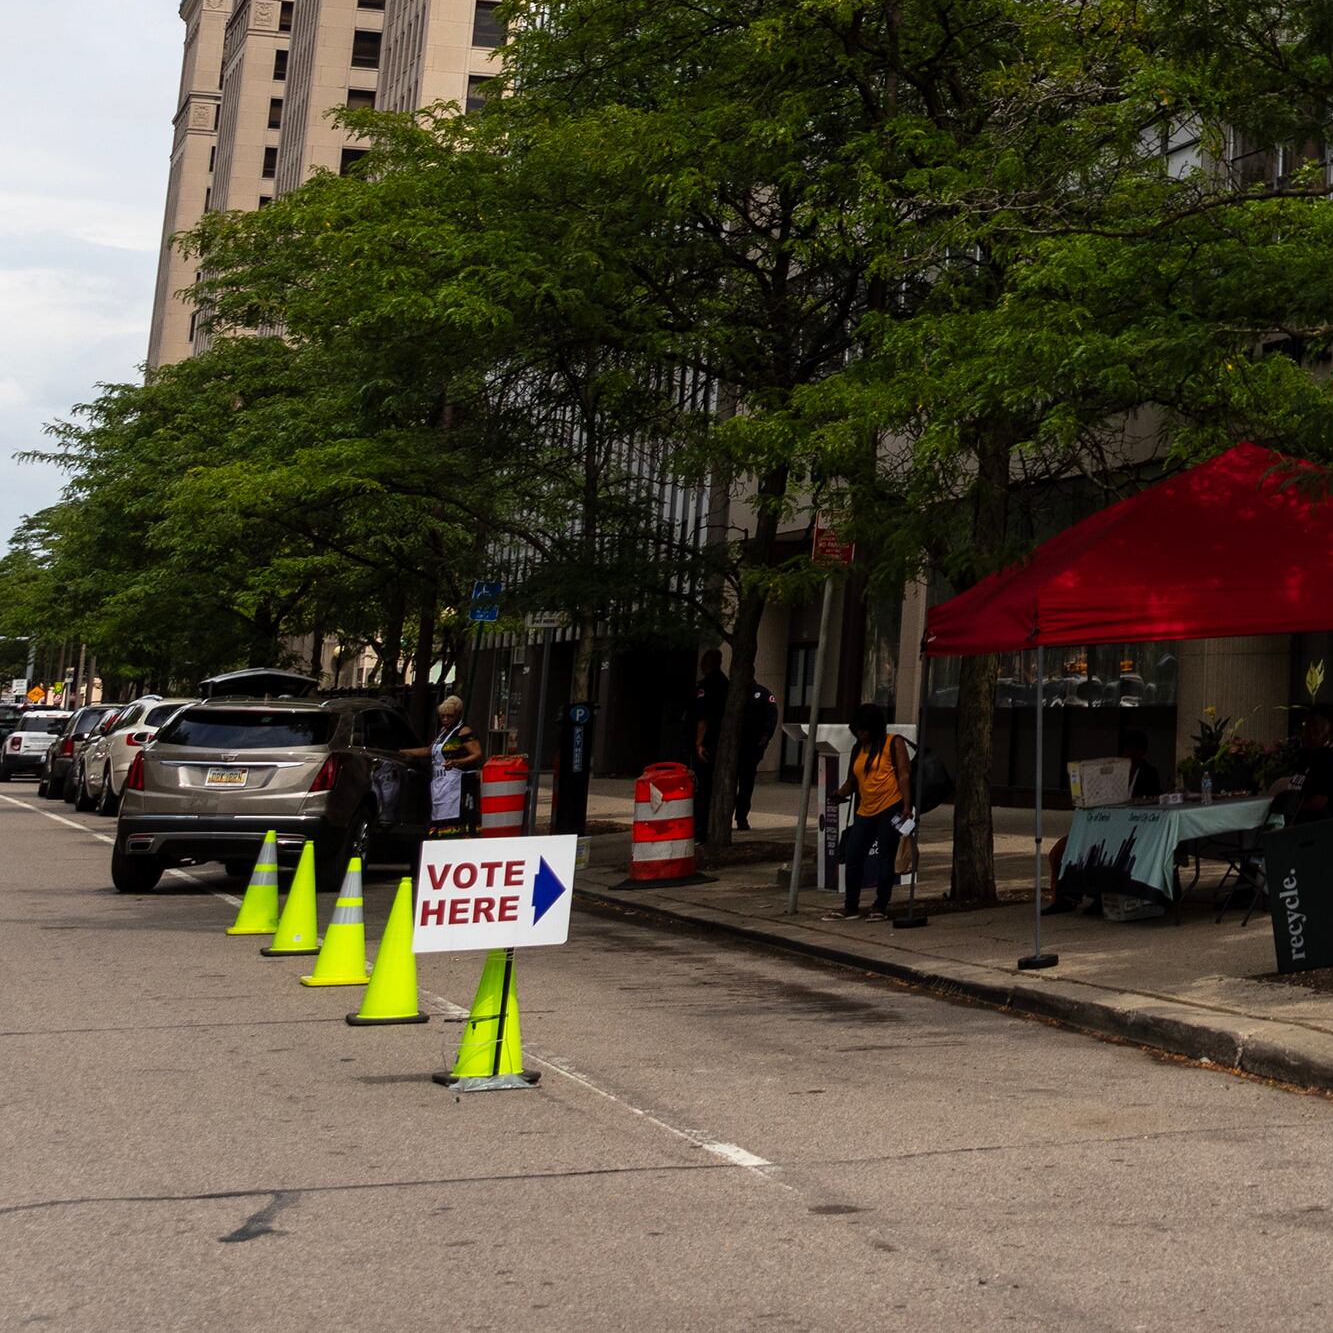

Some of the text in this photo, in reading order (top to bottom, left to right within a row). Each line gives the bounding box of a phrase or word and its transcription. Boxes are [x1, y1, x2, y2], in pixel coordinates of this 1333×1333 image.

[426, 859, 526, 890] VOTE
[419, 895, 520, 927] HERE
[1279, 868, 1307, 961] recycle.
